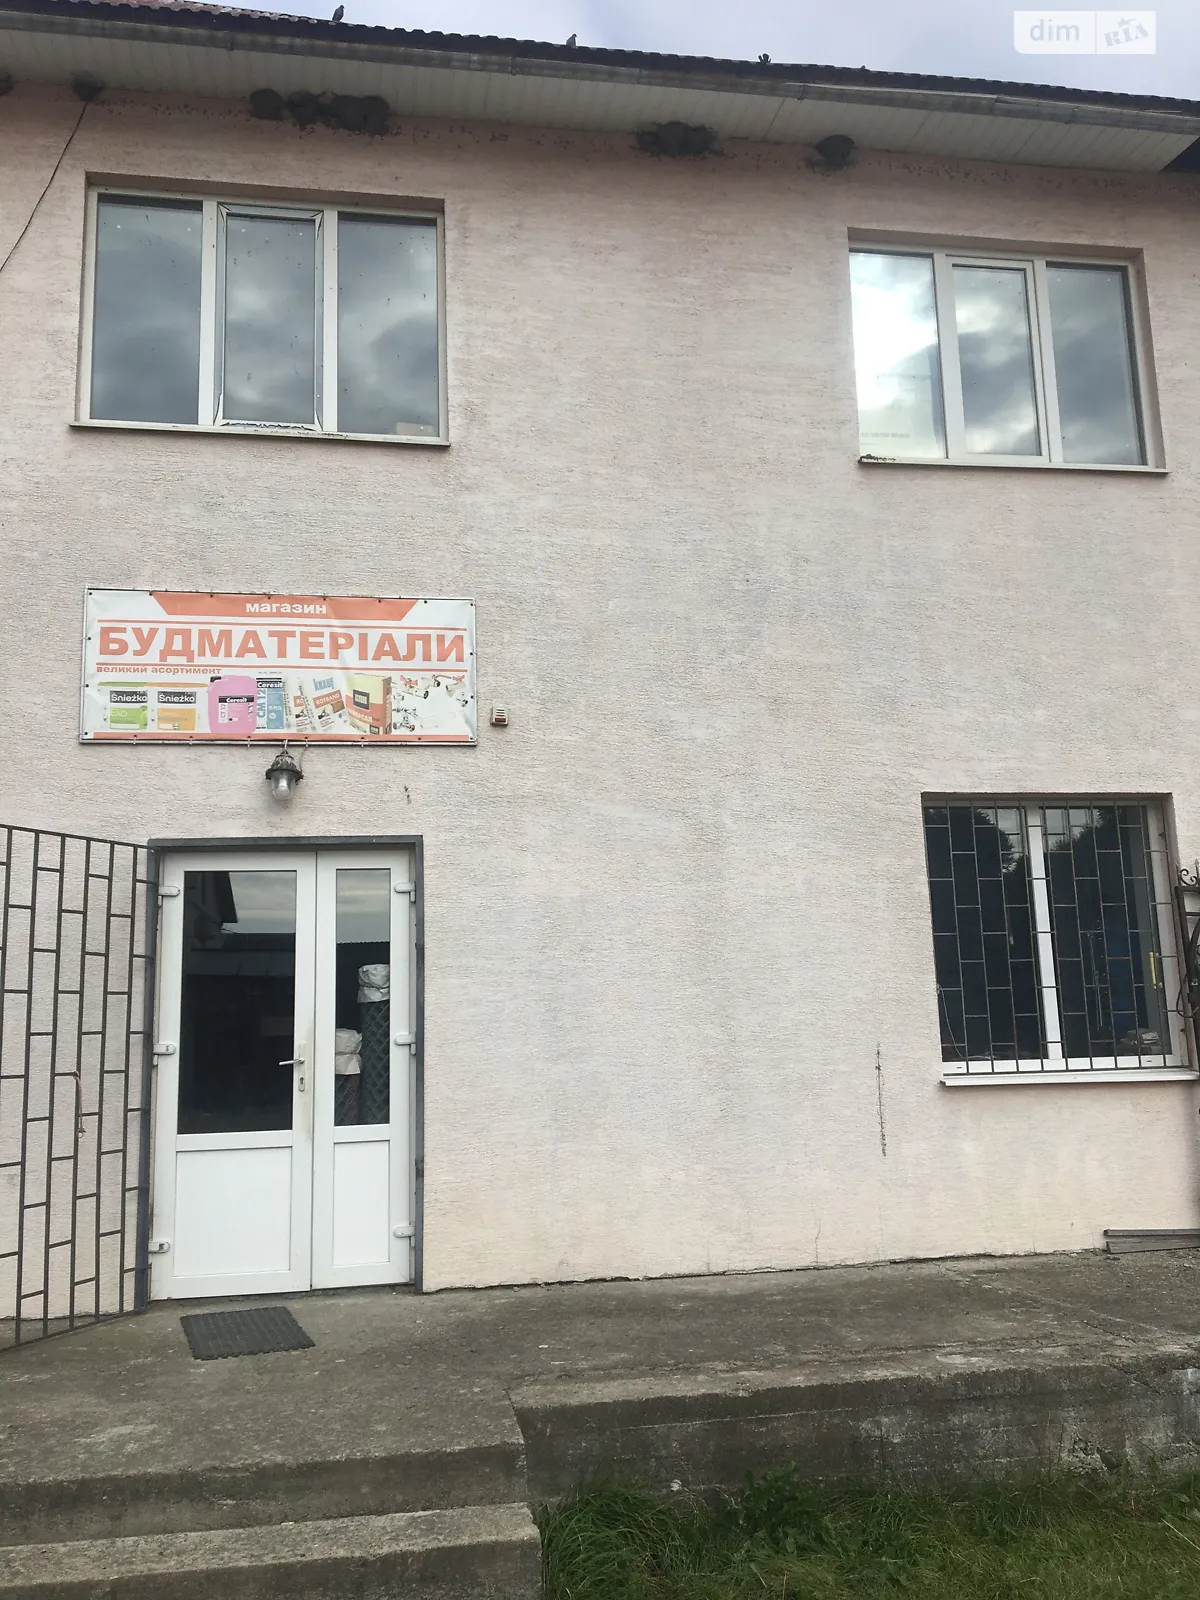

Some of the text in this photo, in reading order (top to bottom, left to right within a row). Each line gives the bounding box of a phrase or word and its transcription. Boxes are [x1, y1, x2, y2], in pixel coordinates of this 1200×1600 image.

[245, 601, 327, 615] магазин
[98, 626, 464, 663] БУДМАТЕРІАЛИ
[96, 666, 221, 676] великий асортимент
